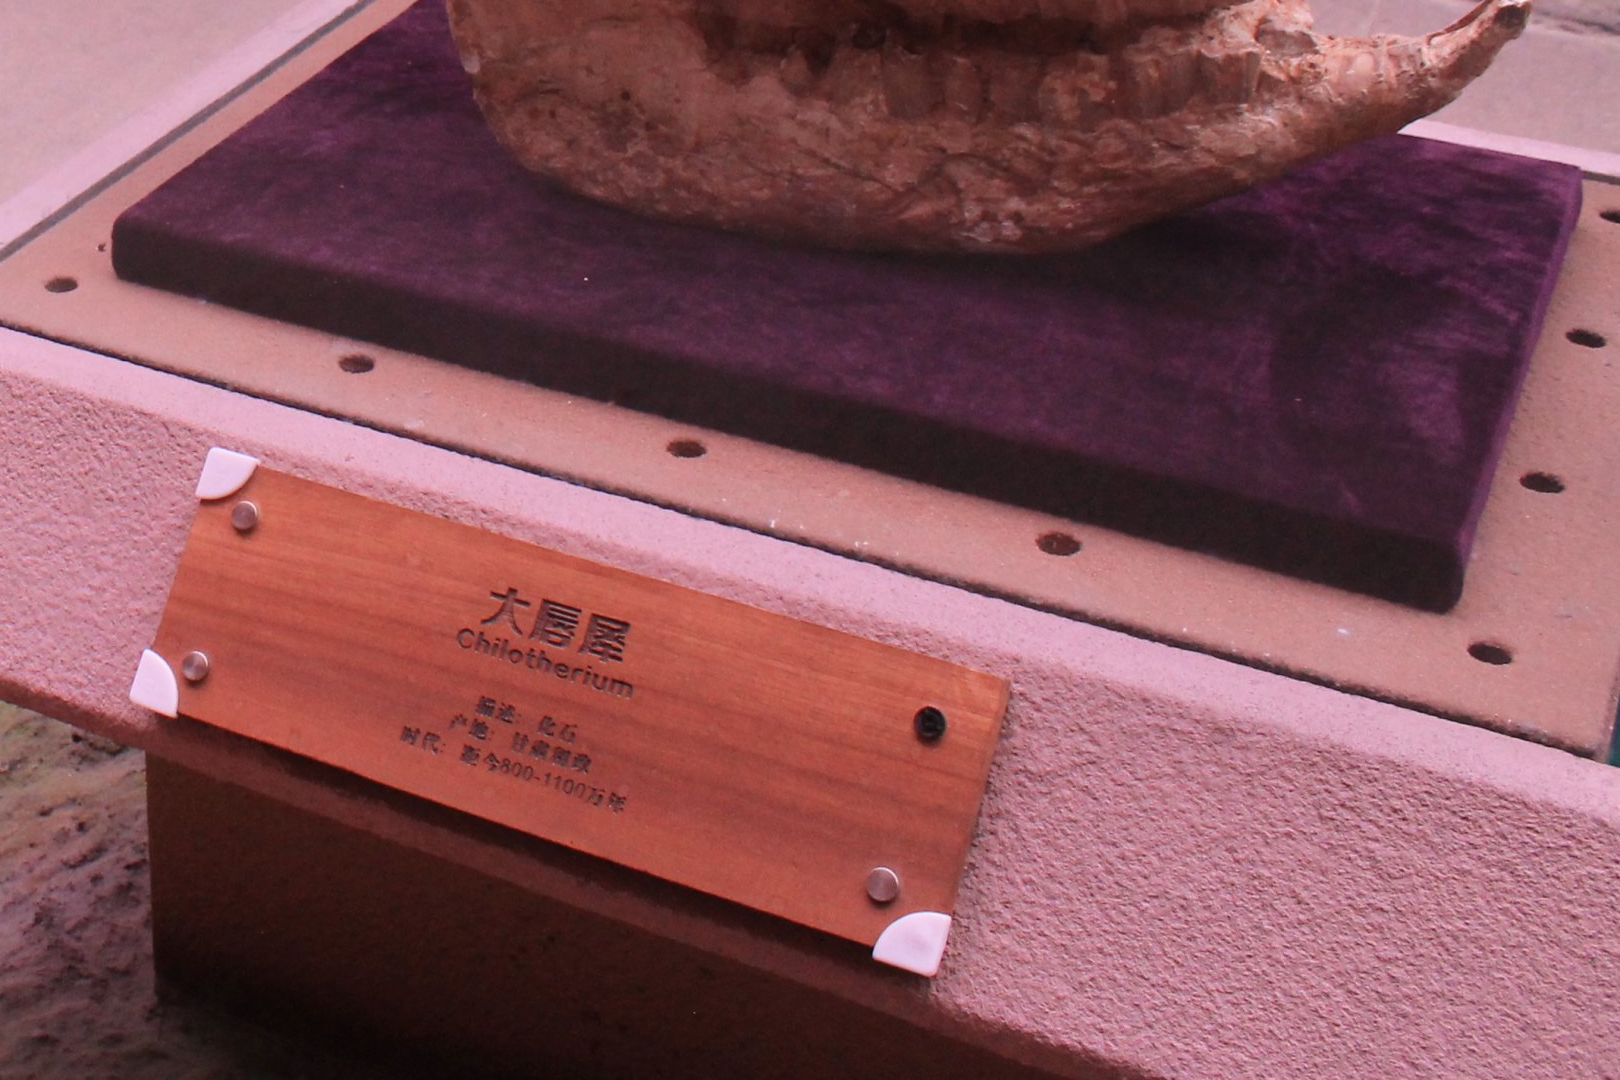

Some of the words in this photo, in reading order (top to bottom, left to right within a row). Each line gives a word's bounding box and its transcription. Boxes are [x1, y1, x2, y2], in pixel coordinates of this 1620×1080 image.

[481, 587, 631, 663] 大唇犀
[456, 628, 634, 699] Chilotherium
